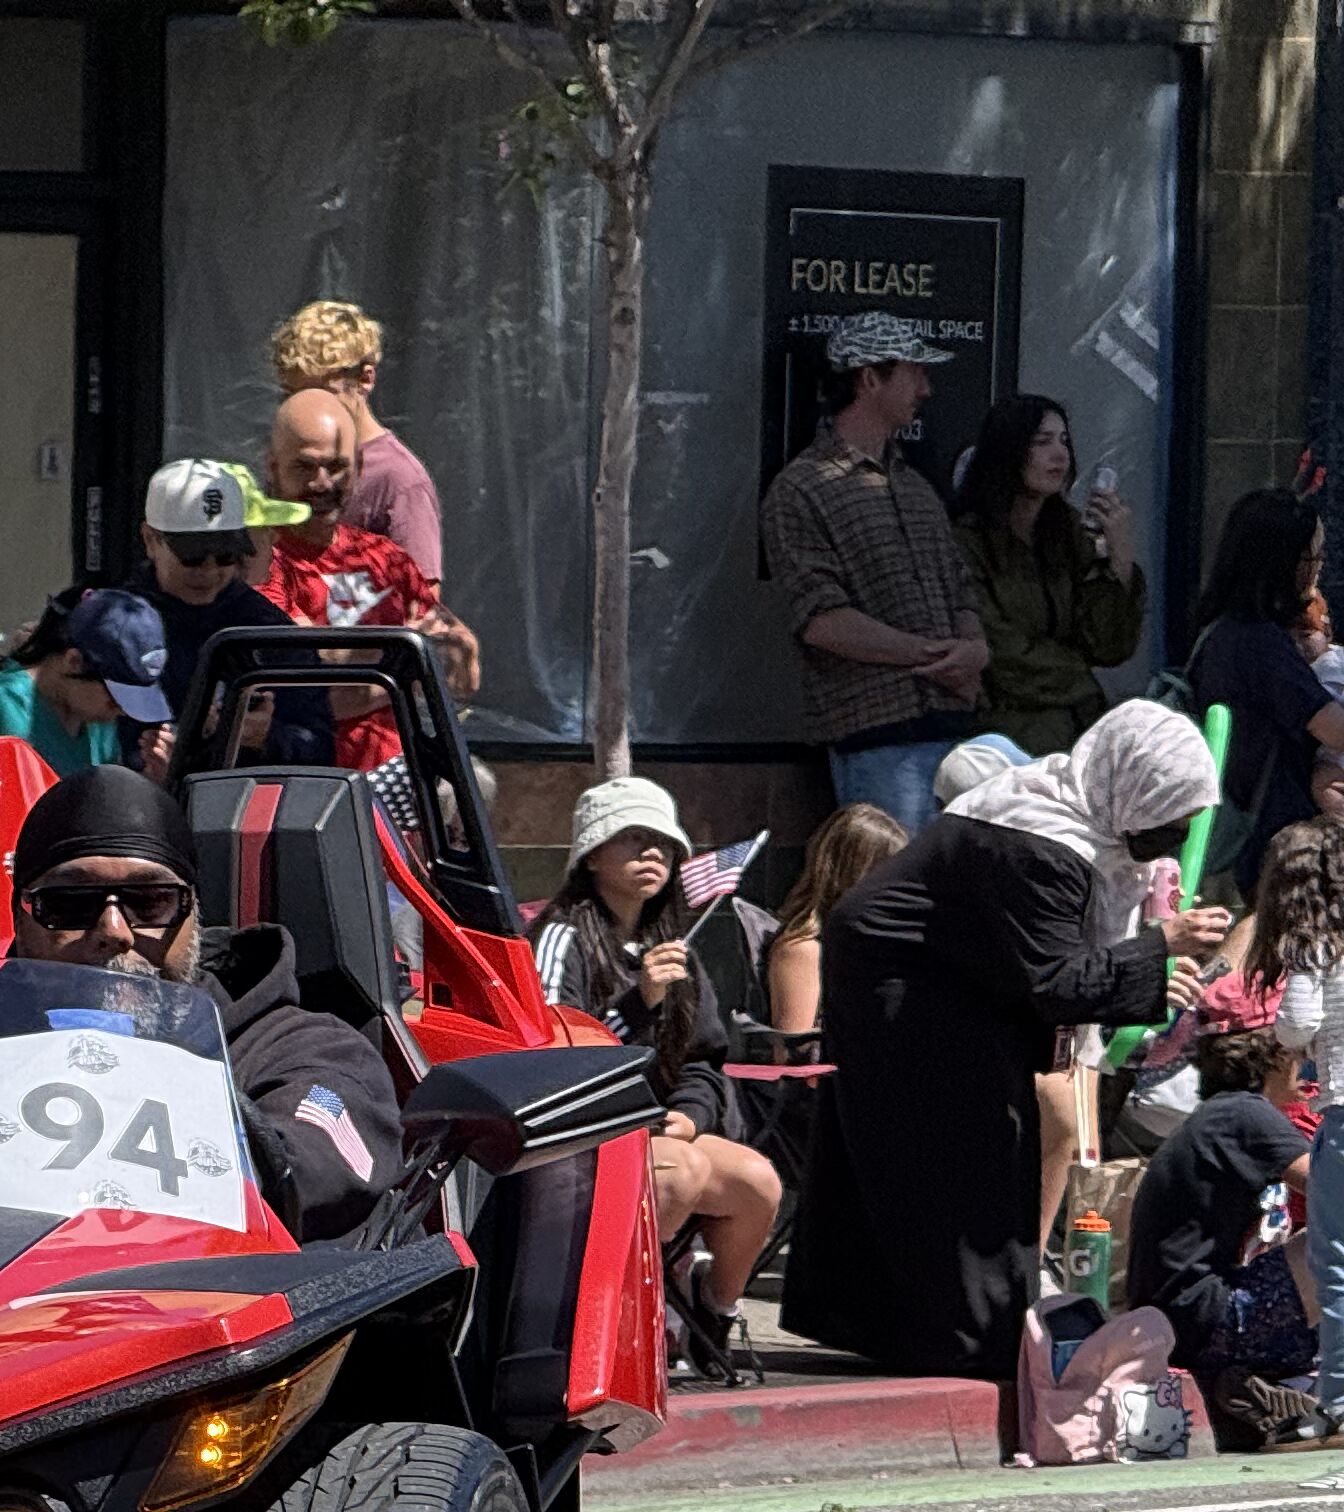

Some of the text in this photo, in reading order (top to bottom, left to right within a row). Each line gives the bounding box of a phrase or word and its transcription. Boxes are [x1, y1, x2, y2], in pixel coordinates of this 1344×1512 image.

[791, 258, 934, 298] FOR LEASE
[938, 319, 984, 341] SPACE
[18, 1081, 188, 1197] 94
